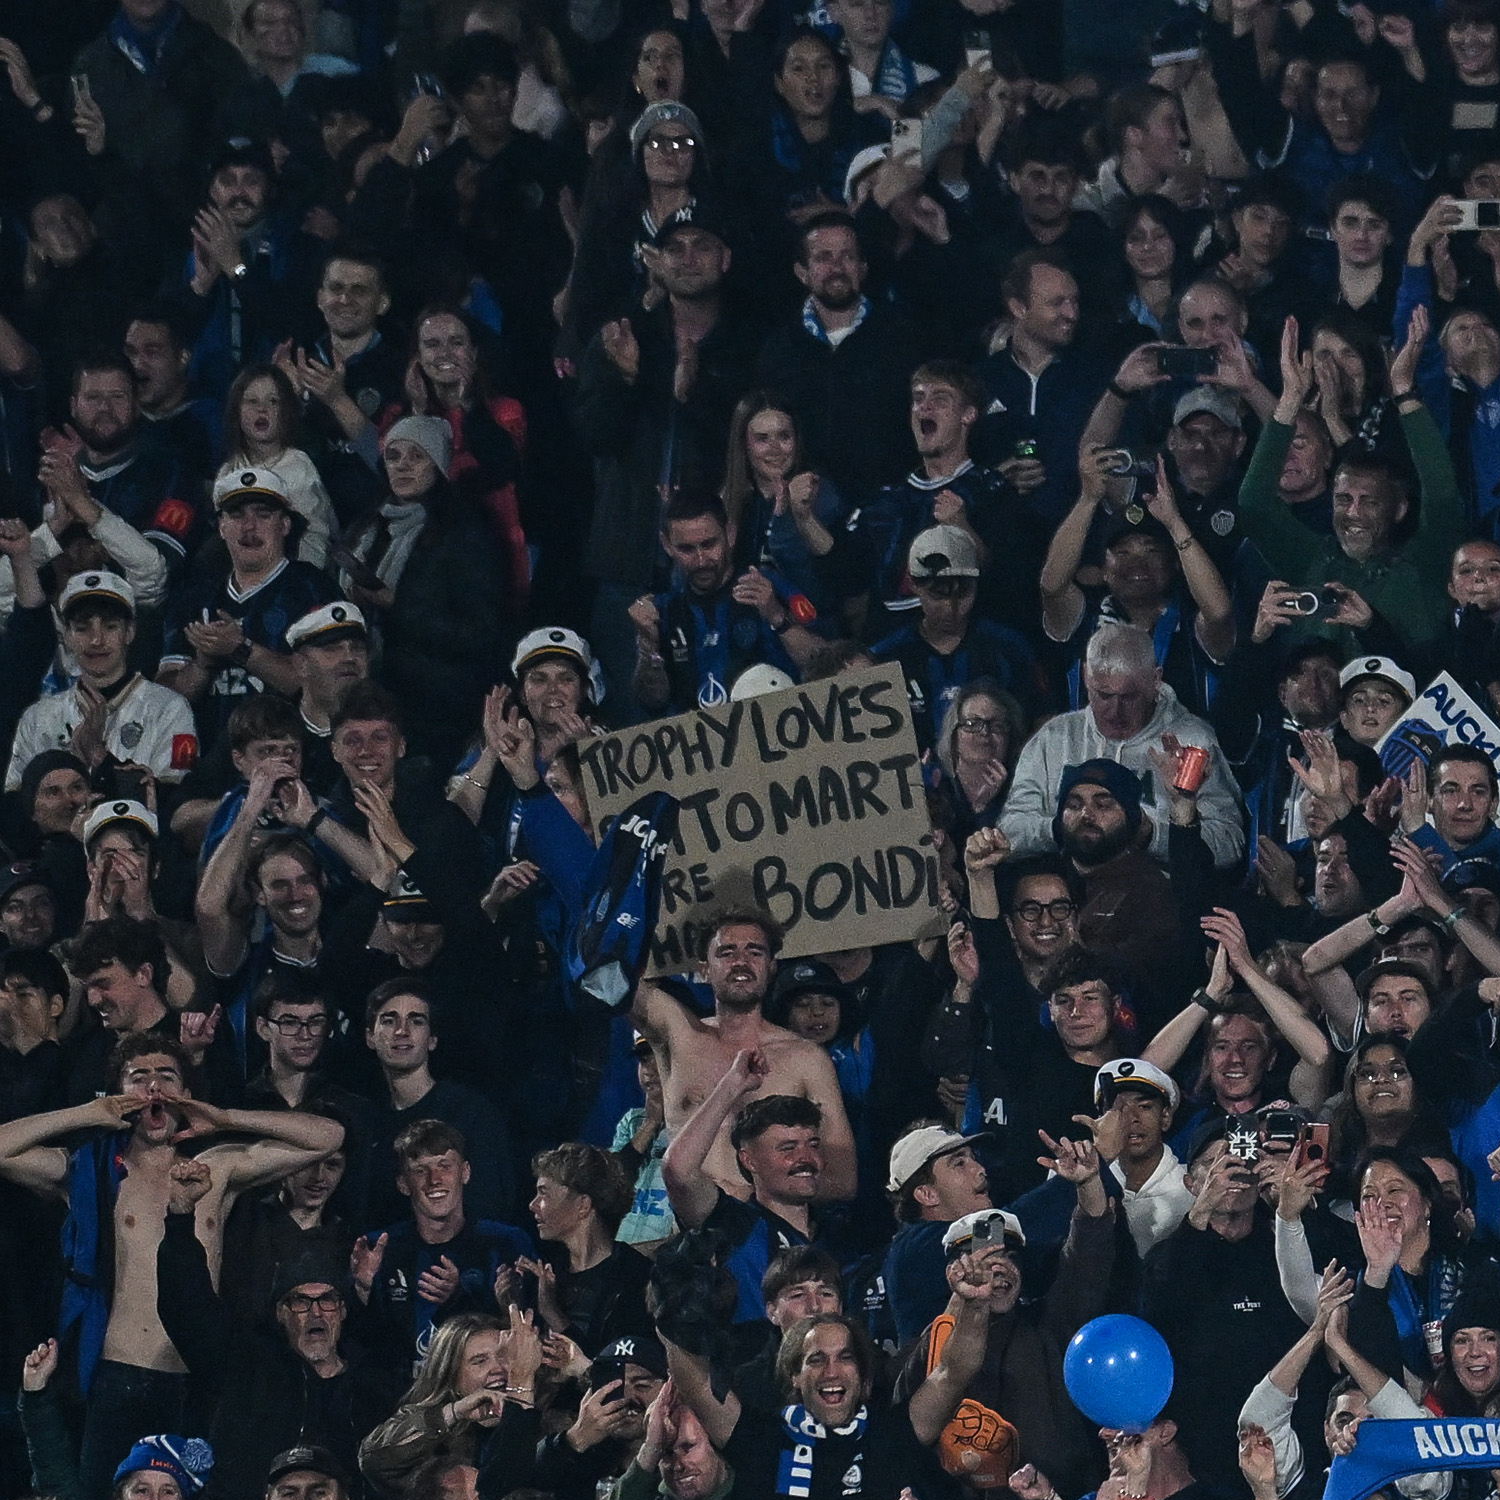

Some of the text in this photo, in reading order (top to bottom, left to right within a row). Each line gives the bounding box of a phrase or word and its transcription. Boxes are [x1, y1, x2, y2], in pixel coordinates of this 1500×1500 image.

[580, 683, 902, 799] TROPHY LOVES
[768, 753, 918, 837] MART
[614, 1338, 637, 1356] NY
